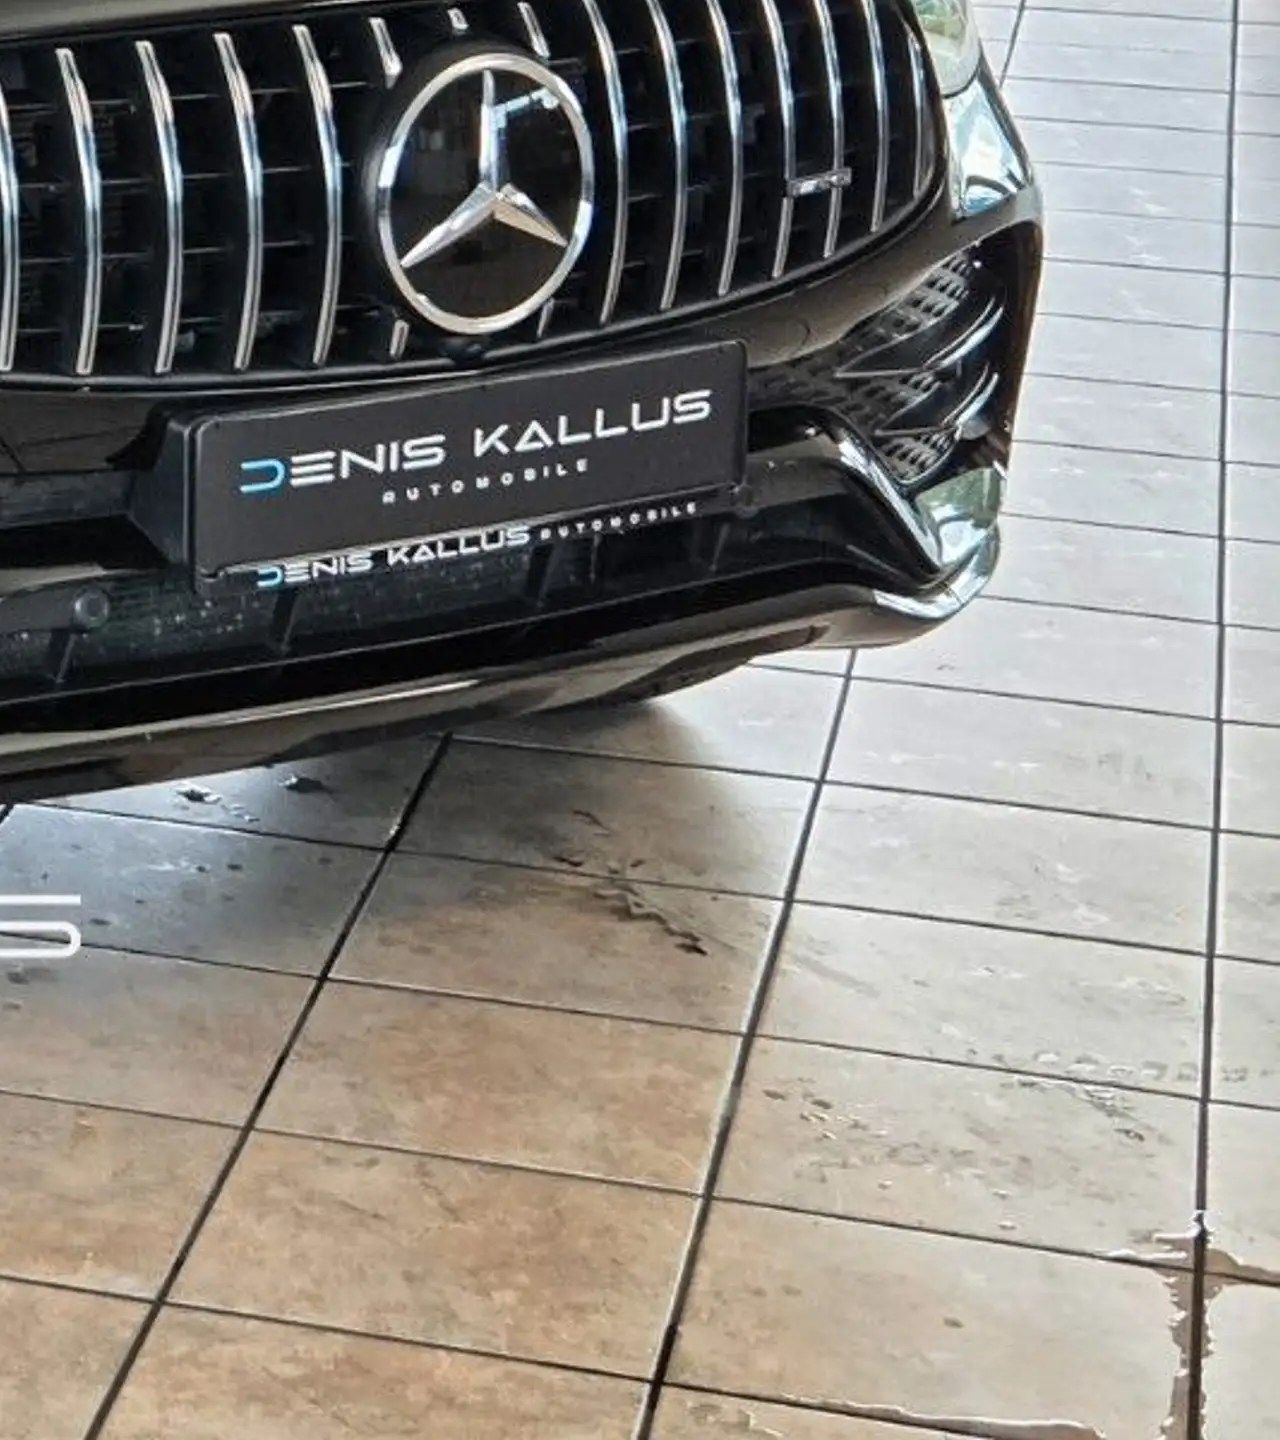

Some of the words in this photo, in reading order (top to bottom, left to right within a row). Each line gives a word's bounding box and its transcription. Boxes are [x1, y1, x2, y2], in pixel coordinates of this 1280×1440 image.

[241, 433, 446, 493] DENIS
[474, 389, 712, 458] KALLUS
[382, 458, 588, 505] AUTOMOBILE
[256, 550, 374, 587] DENIS
[386, 524, 531, 565] KALLUS
[540, 501, 696, 541] AUTOMOBILE
